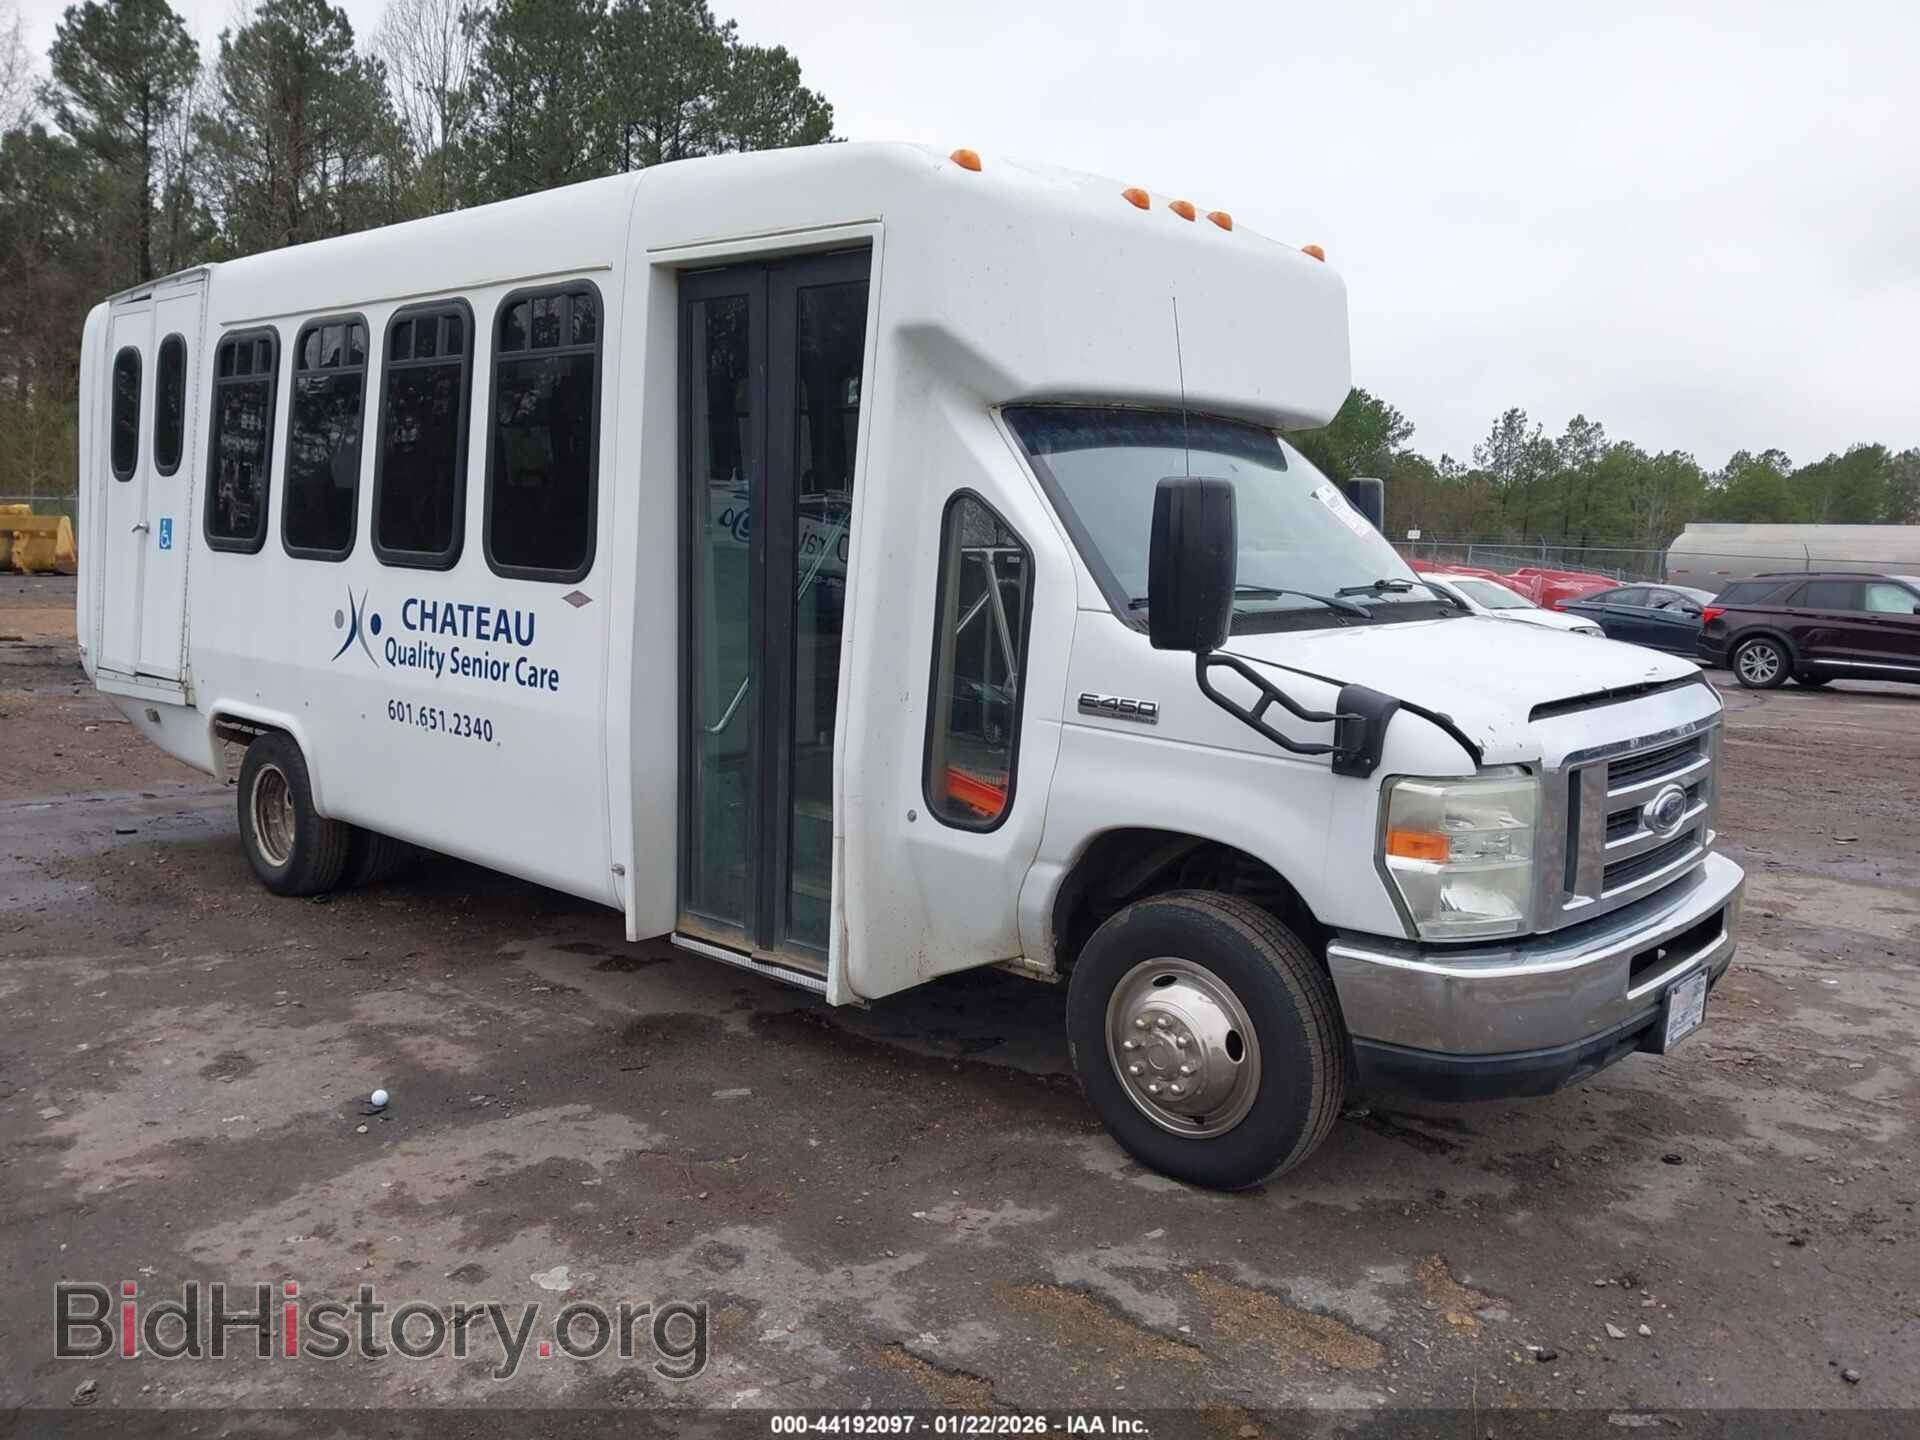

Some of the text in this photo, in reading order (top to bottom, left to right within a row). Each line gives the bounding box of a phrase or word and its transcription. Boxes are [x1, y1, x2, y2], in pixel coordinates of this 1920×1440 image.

[402, 598, 535, 646] CHATEAU
[385, 637, 560, 691] Quality Senior Care
[388, 700, 493, 742] 601.651.2340
